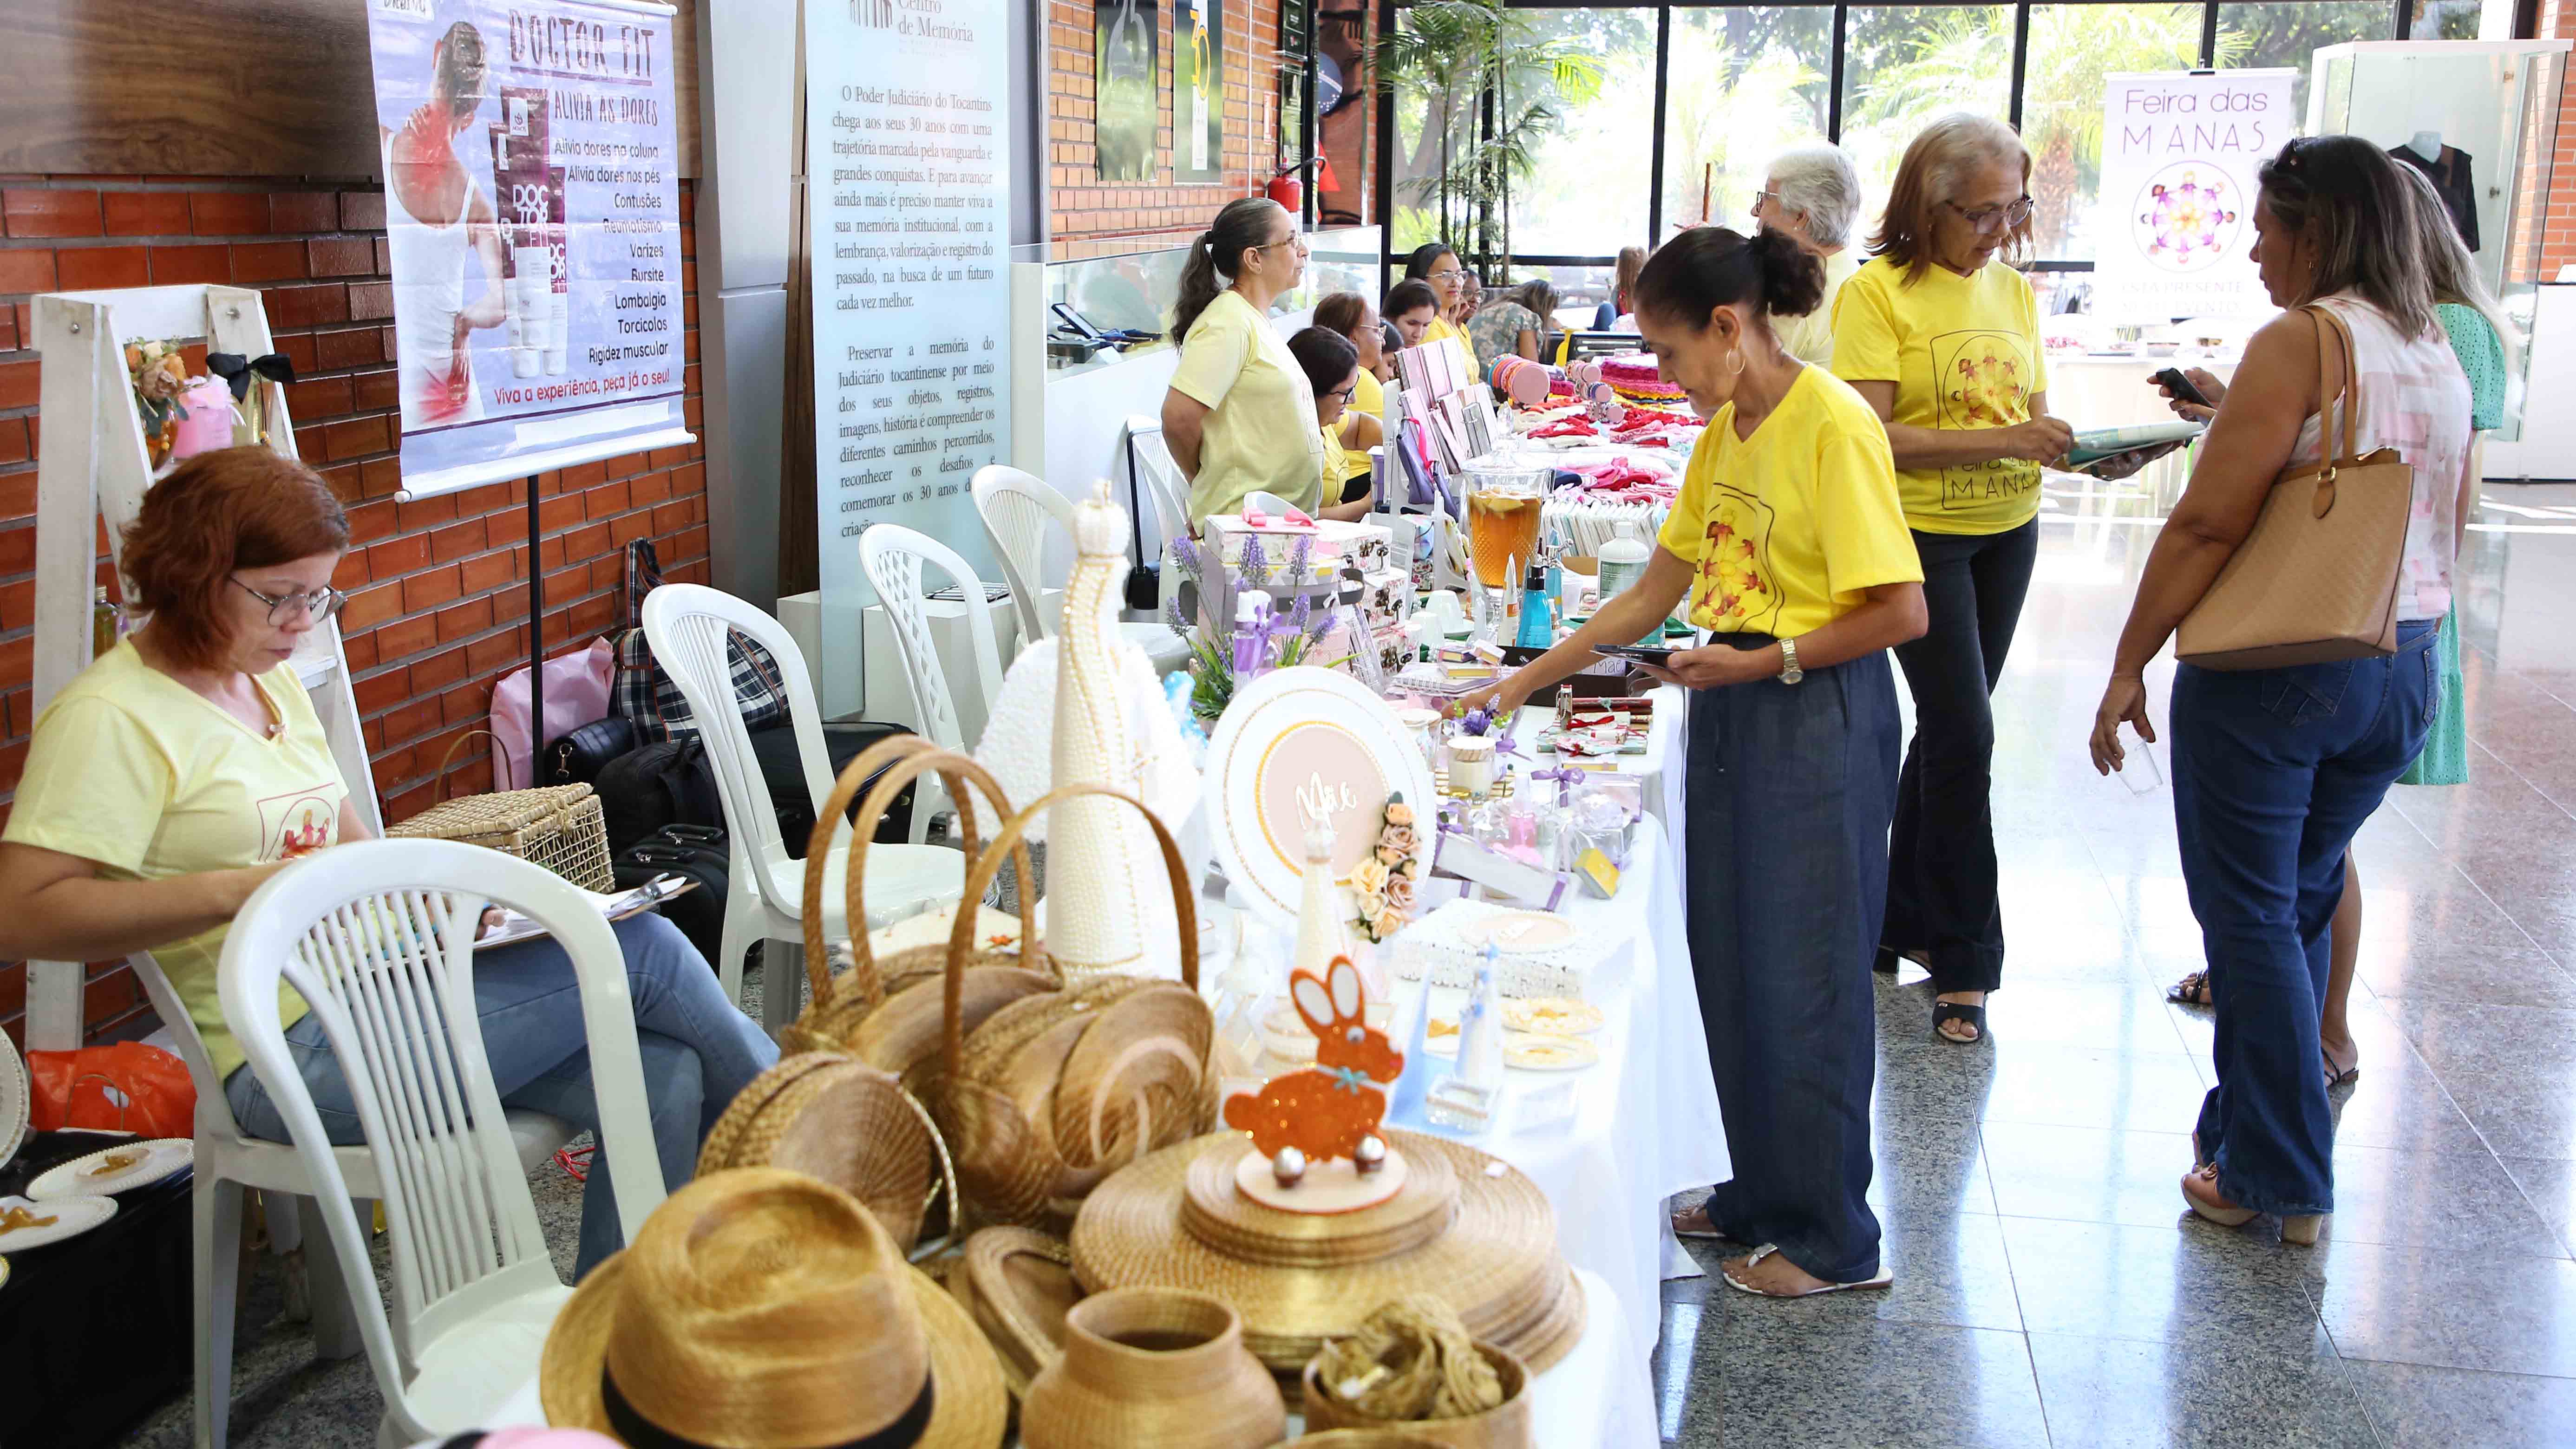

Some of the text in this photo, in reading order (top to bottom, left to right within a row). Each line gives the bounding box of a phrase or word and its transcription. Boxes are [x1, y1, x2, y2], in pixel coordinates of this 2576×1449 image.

[899, 15, 974, 42] de Memória
[510, 9, 654, 78] DOCTOR FIT
[555, 91, 658, 126] ALIVIA AS DORES
[842, 85, 992, 111] O Poder Judiciário do Tocantins
[2125, 88, 2268, 114] Feira das
[832, 111, 992, 136] chega aos seus 30 anos com uma
[555, 137, 658, 159] Alivia dores na coluna
[2123, 120, 2265, 155] MANAS
[832, 138, 992, 163] trajetória marcada pela vanguarda e
[568, 165, 660, 187] Alivia dores nos pés
[834, 164, 993, 188] grandes conquistas. E para avançar
[513, 184, 549, 207] DOC
[615, 192, 661, 209] Contusões
[834, 190, 993, 211] ainda mais é preciso manter viva a
[603, 217, 662, 233] Reumatismo
[835, 216, 993, 234] sua memória institucional, com a
[630, 242, 664, 258] Varizes
[836, 241, 993, 262] lembrança, valorização e registro do
[632, 268, 664, 281] Bursite
[836, 265, 994, 289] passado, na busca de um futuro
[615, 292, 667, 310] Lombalgia
[837, 292, 914, 310] cada vez melhor.
[618, 316, 667, 334] Torcicolos
[589, 340, 668, 366] Rigidez muscular
[848, 335, 994, 361] Preservar a memória do
[494, 368, 670, 405] Viva a experiência, peça já o seu!
[838, 359, 995, 390] Judiciário tocantinense por meio
[839, 384, 995, 412] dos seus objetos, registros,
[839, 406, 995, 440] imagens, história é compreender os
[840, 430, 995, 463] diferentes caminhos percorridos,
[841, 453, 995, 488] reconhecer os desafios e
[841, 492, 896, 513] comemorar
[903, 490, 914, 503] os
[920, 485, 931, 500] 30
[938, 483, 958, 497] anos
